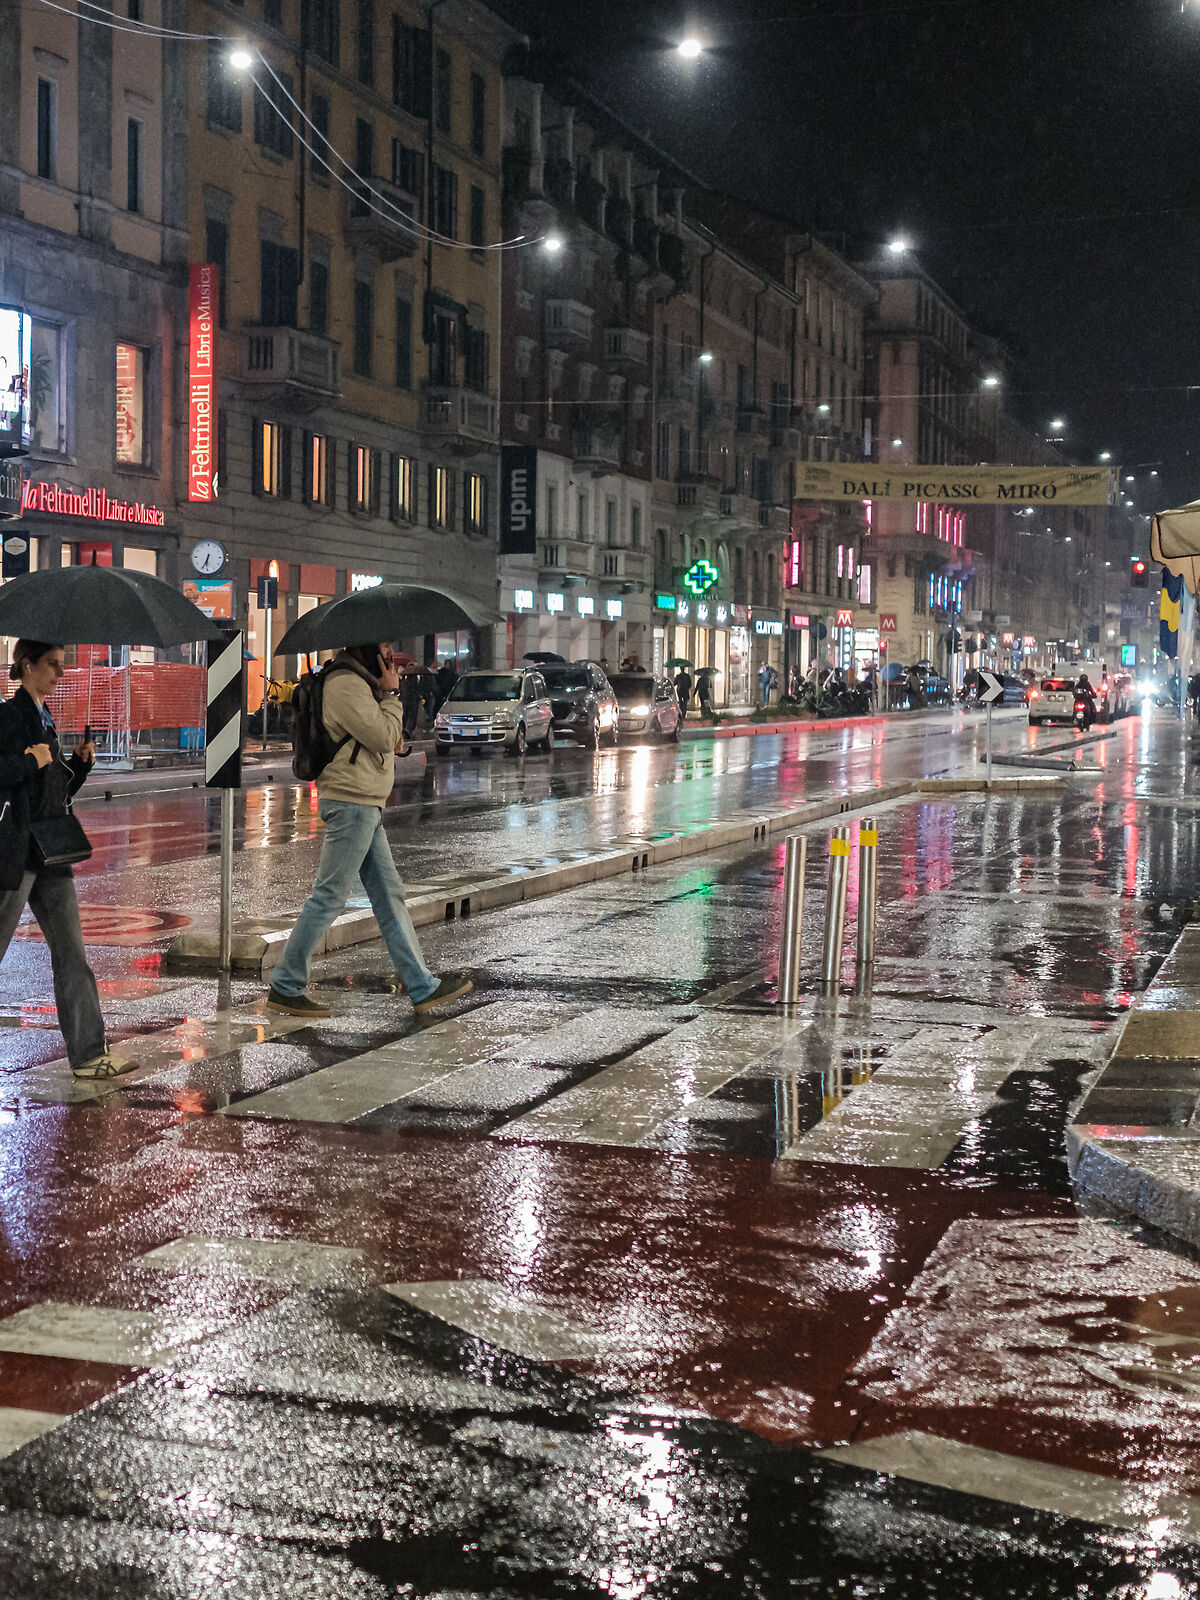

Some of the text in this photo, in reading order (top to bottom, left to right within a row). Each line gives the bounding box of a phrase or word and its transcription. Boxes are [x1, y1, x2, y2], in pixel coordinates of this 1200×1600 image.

[198, 267, 210, 321] Musica
[197, 335, 210, 368] Libri
[191, 383, 210, 477] Feltrinelli
[23, 479, 37, 510] la
[39, 482, 102, 519] Feltrinelli
[106, 498, 126, 521] Libri
[135, 502, 165, 526] Musica
[191, 481, 209, 500] la
[511, 468, 532, 531] upim
[903, 483, 983, 499] PICASSO
